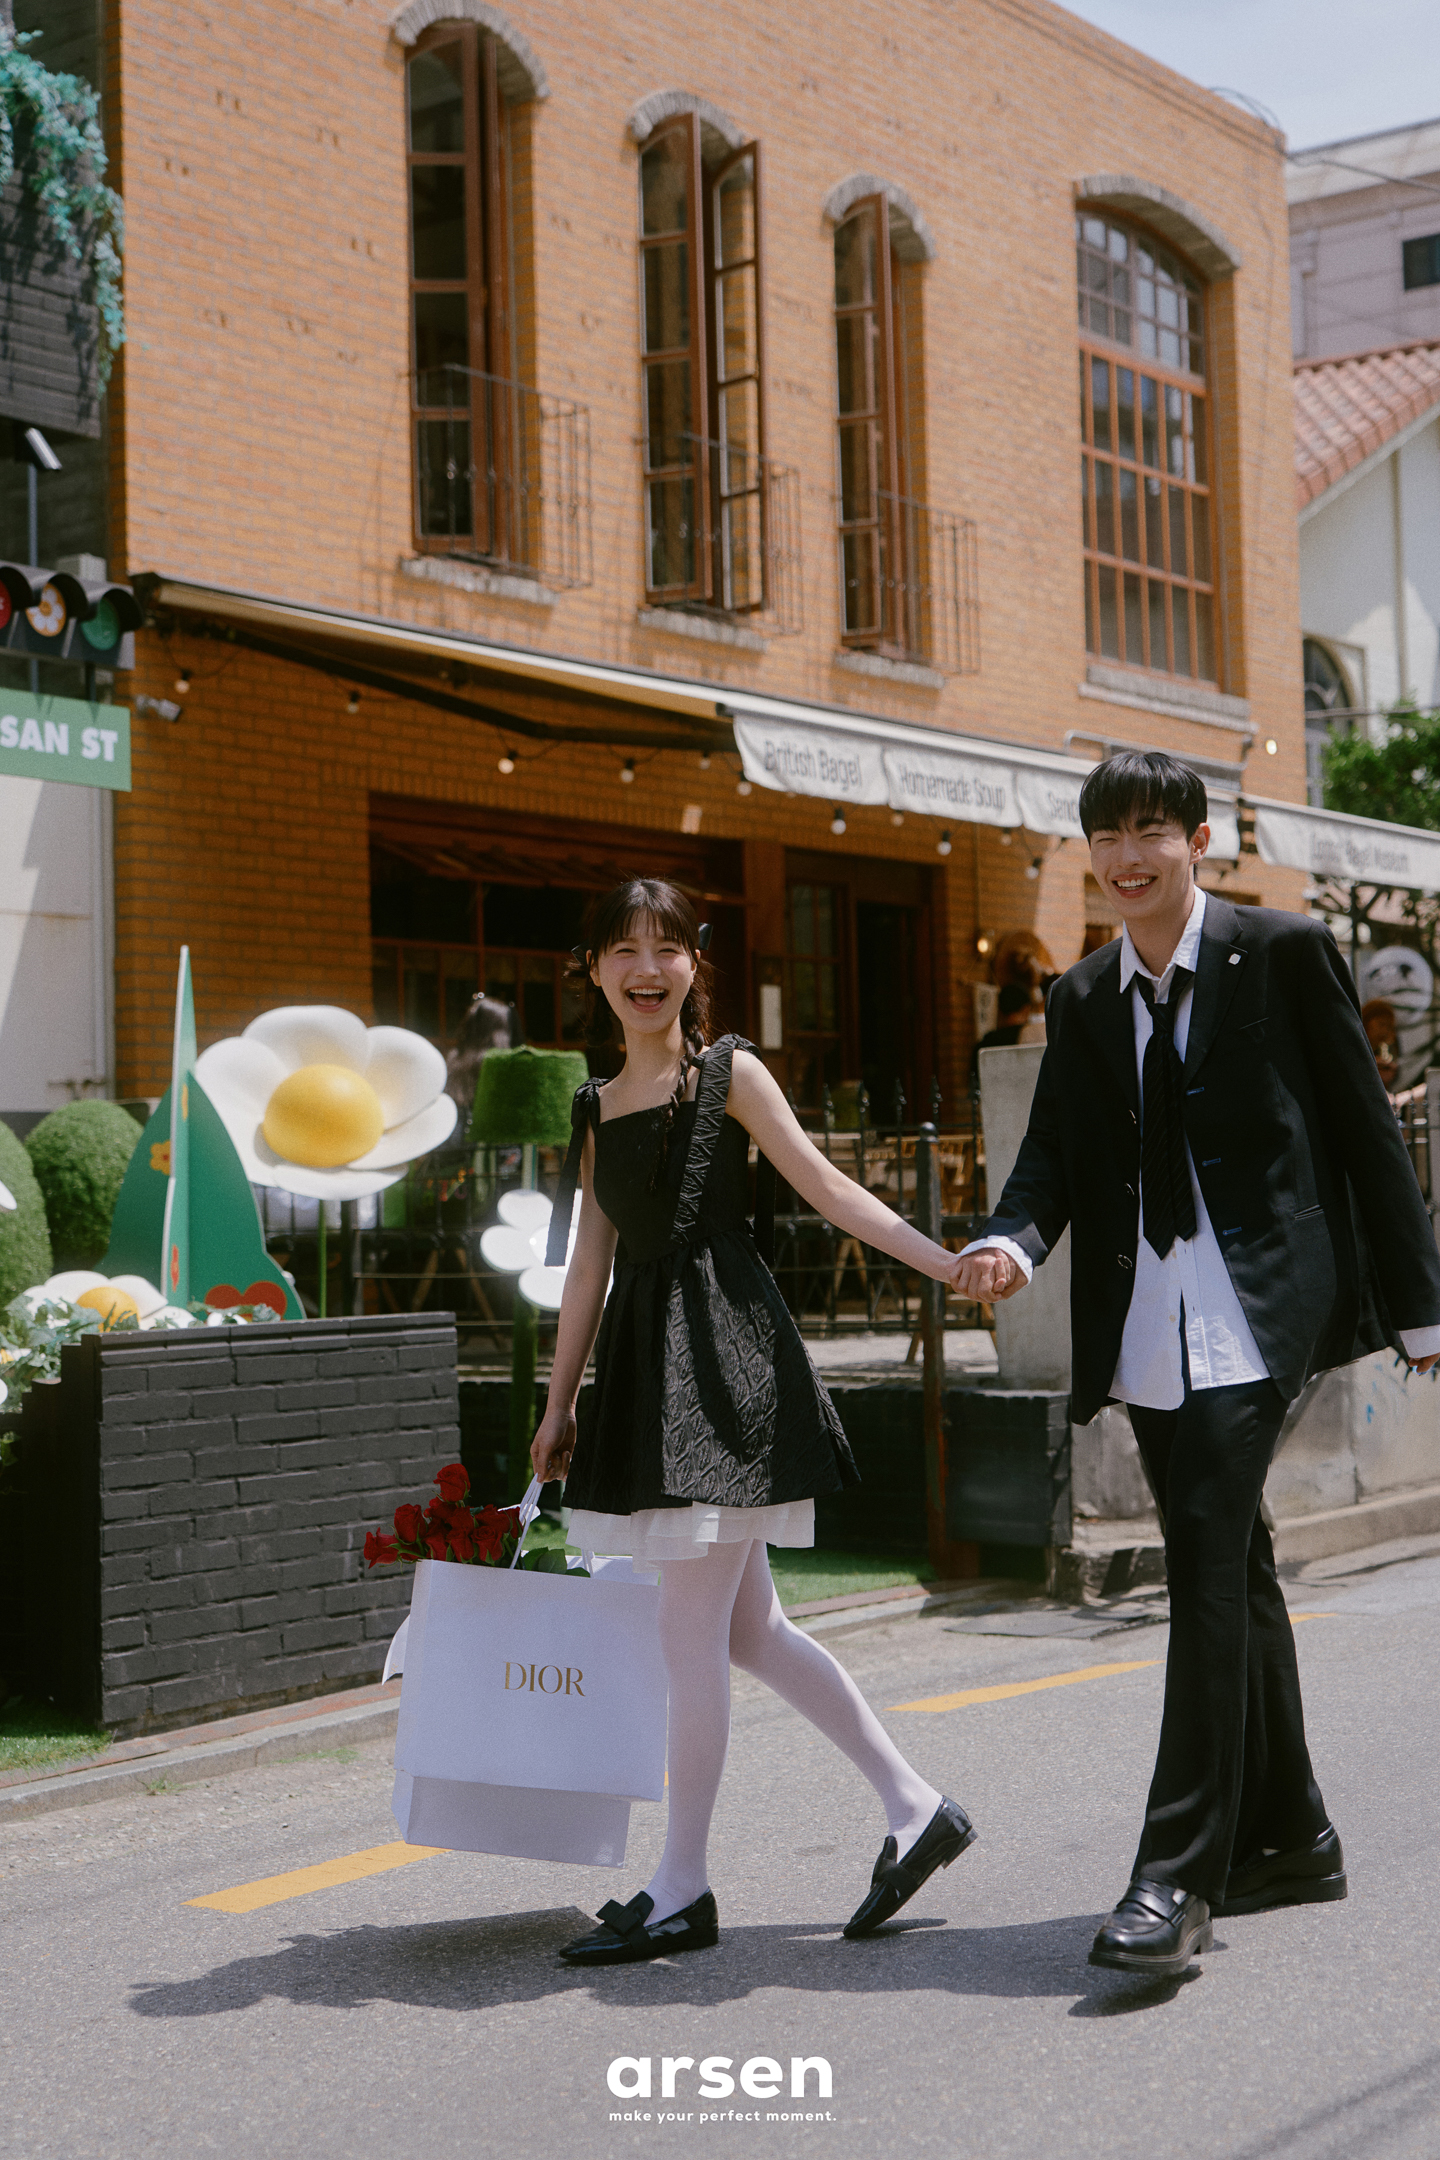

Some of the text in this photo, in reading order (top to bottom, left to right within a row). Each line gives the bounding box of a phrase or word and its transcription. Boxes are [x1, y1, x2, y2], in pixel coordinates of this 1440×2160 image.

[0, 714, 118, 762] SAN ST
[764, 739, 862, 791] British Bagel
[900, 765, 1006, 816] Homemade Soup
[502, 1661, 586, 1697] DIOR
